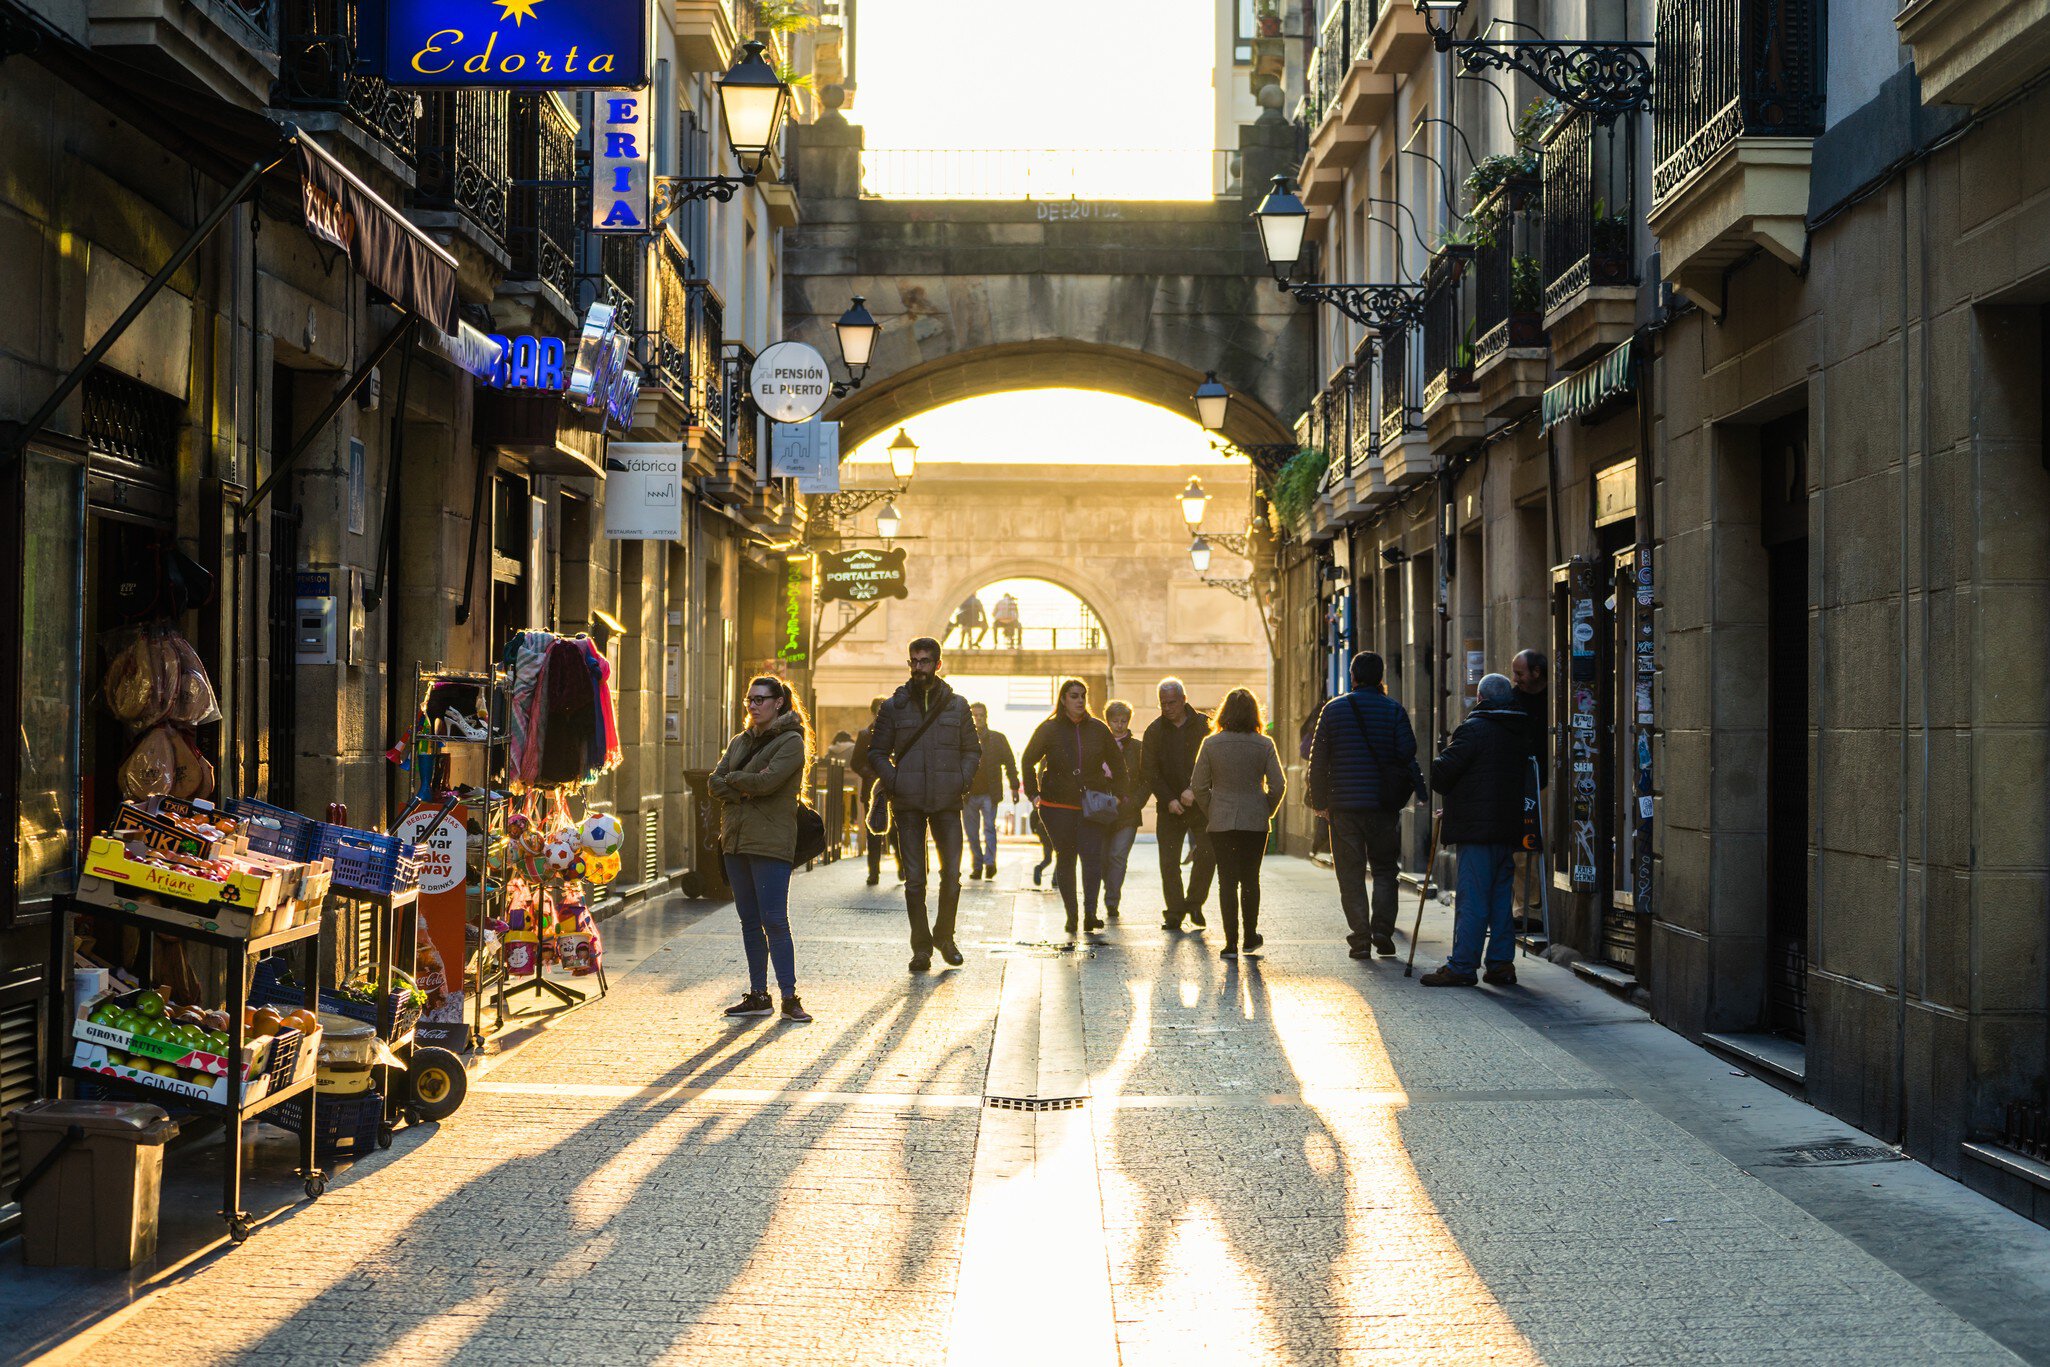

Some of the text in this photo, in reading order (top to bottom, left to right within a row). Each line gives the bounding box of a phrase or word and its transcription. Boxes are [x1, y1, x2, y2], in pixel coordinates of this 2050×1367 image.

[411, 29, 615, 74] Edorta
[486, 334, 565, 390] BAR
[775, 366, 823, 379] PENSIÓN
[762, 384, 822, 395] EL PUERTO
[627, 459, 676, 472] fábrica
[827, 570, 899, 581] PORTALETAS
[165, 801, 188, 814] TXIKI
[405, 813, 459, 829] BEBIDAS RÍAS
[122, 817, 181, 852] TXIKI
[416, 825, 448, 836] Pra
[424, 851, 451, 864] ake
[419, 866, 452, 878] way
[146, 869, 195, 893] Ariane
[427, 880, 454, 891] DRINKS
[86, 1027, 163, 1055] GIRONA FRUITS
[141, 1076, 209, 1099] GIMENO
